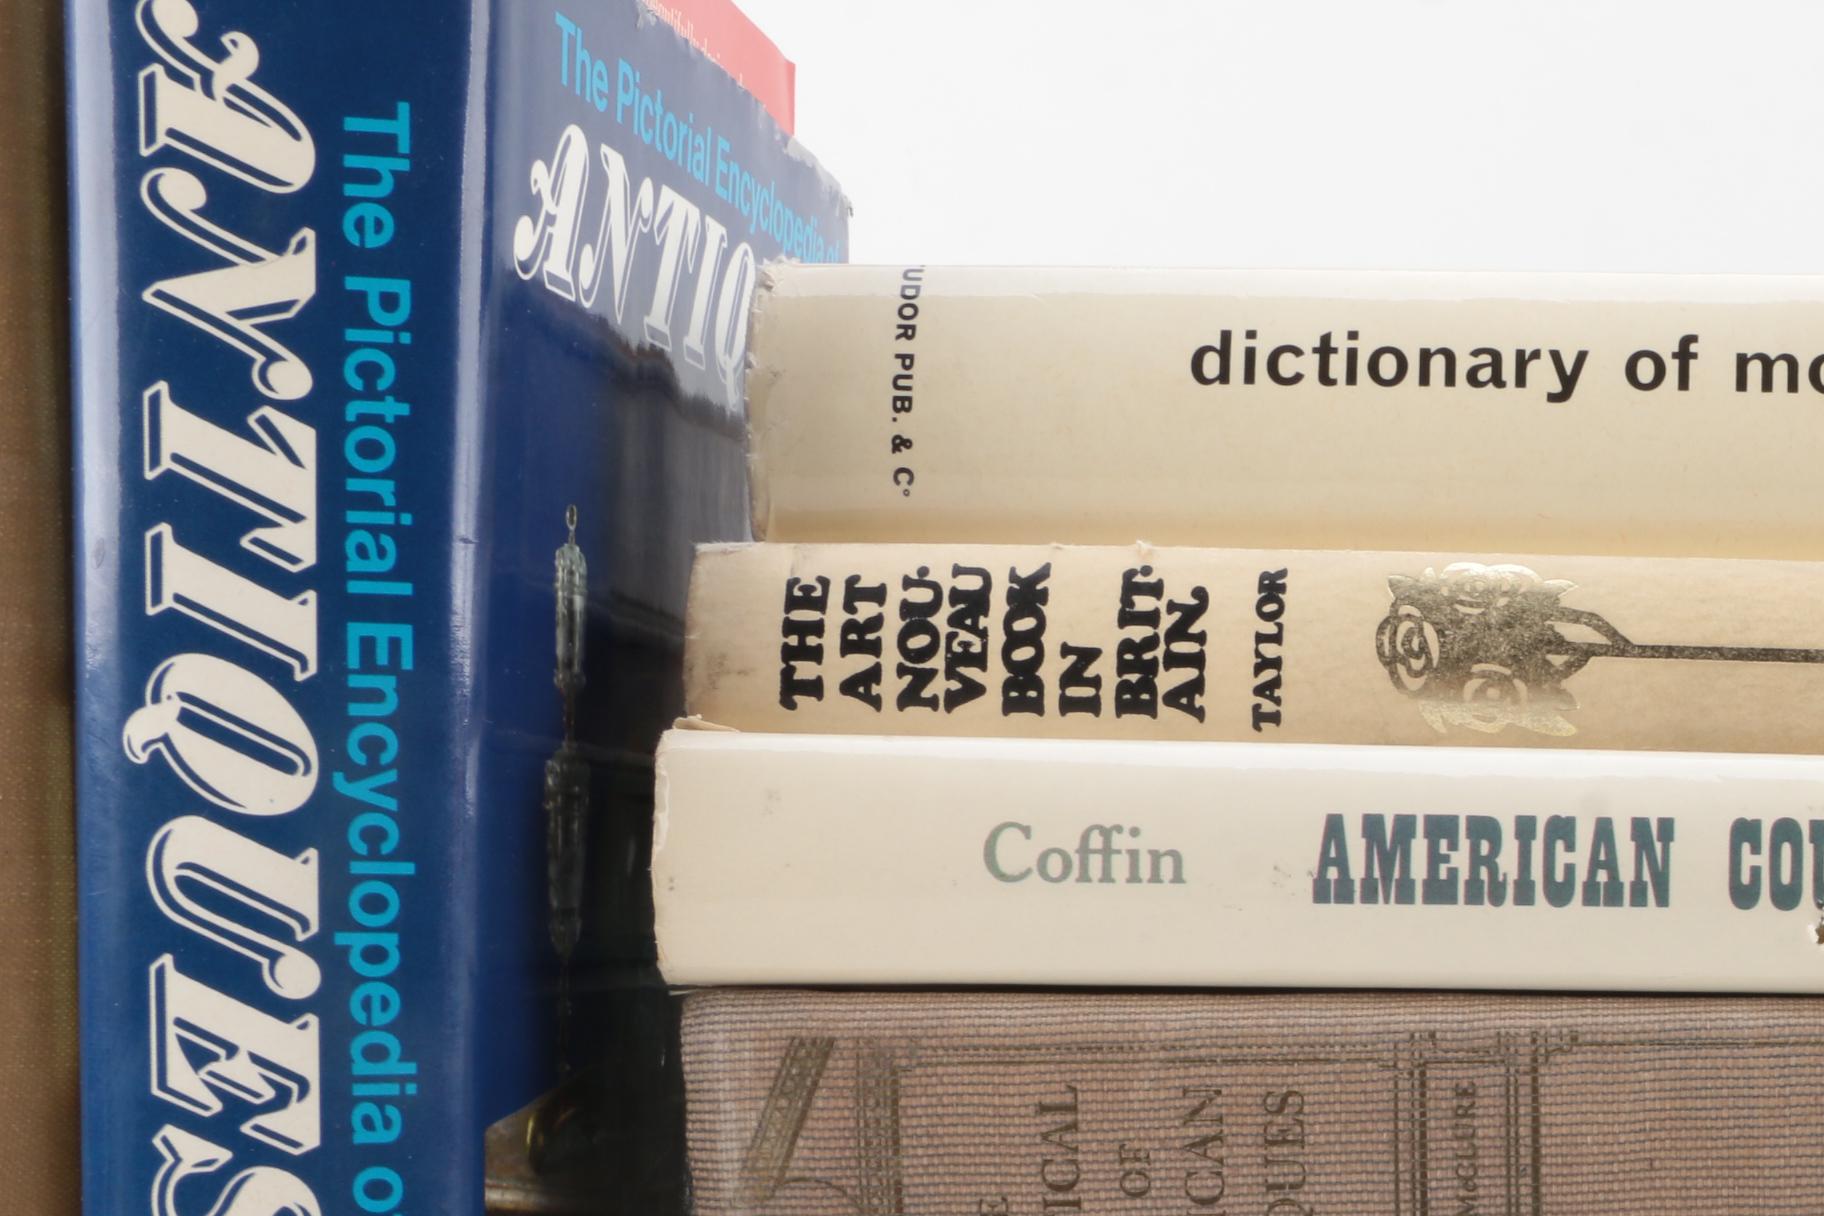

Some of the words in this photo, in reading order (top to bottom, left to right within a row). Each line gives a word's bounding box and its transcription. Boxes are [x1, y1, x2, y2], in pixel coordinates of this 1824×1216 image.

[343, 102, 411, 248] The
[555, 12, 609, 112] The
[616, 58, 711, 186] Pictorial
[715, 136, 826, 264] Encyclopedia
[514, 124, 756, 412] ANTIQ
[895, 265, 925, 341] UDOR
[892, 353, 914, 422] PUB.
[1190, 330, 1588, 403] dictionary
[1625, 334, 1699, 391] of
[344, 277, 414, 597] Pictorial
[891, 434, 913, 454] &
[779, 574, 830, 711] THE
[839, 574, 887, 713] ART
[943, 563, 992, 714] VEAU
[1001, 562, 1052, 717] BOOK
[1058, 641, 1102, 717] IN
[1252, 567, 1288, 733] TAYLOR
[334, 622, 418, 1146] Encyclopedia
[982, 820, 1186, 884] Coffin
[1312, 813, 1675, 908] AMERICAN
[1119, 1143, 1151, 1198] OF
